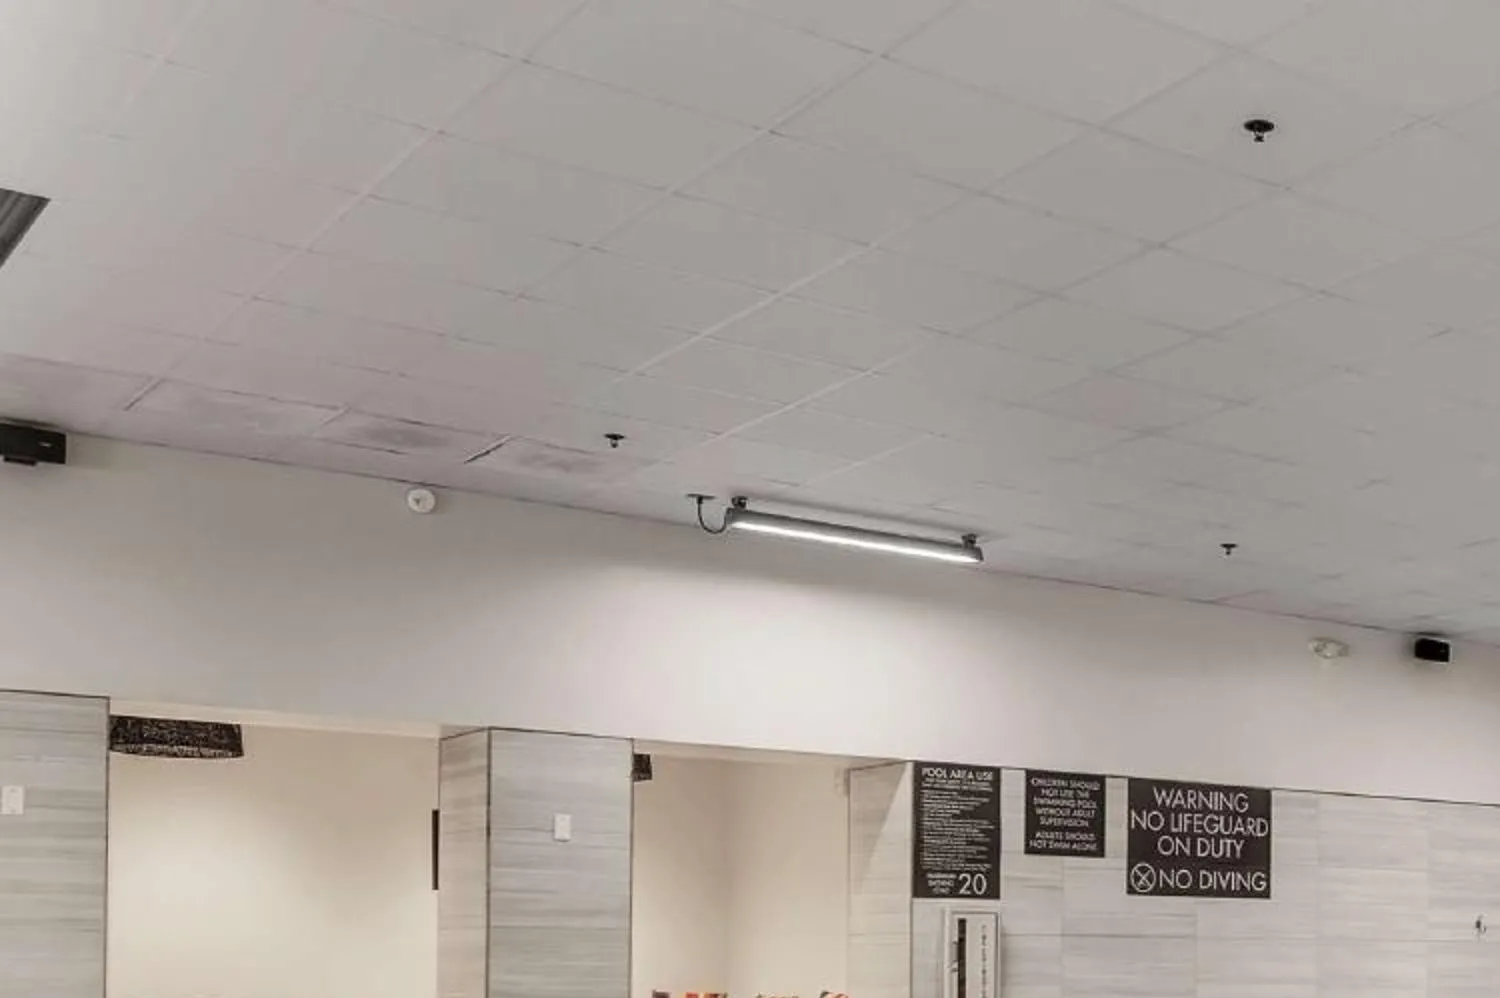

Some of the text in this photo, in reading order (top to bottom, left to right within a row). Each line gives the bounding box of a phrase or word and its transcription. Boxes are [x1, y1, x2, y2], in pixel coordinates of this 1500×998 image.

[1152, 786, 1249, 813] WARNING
[1130, 809, 1269, 837] NO LIFEGUARD
[1158, 835, 1245, 859] ON DUTY
[959, 872, 988, 895] 20
[1159, 869, 1267, 892] NO DIVING
